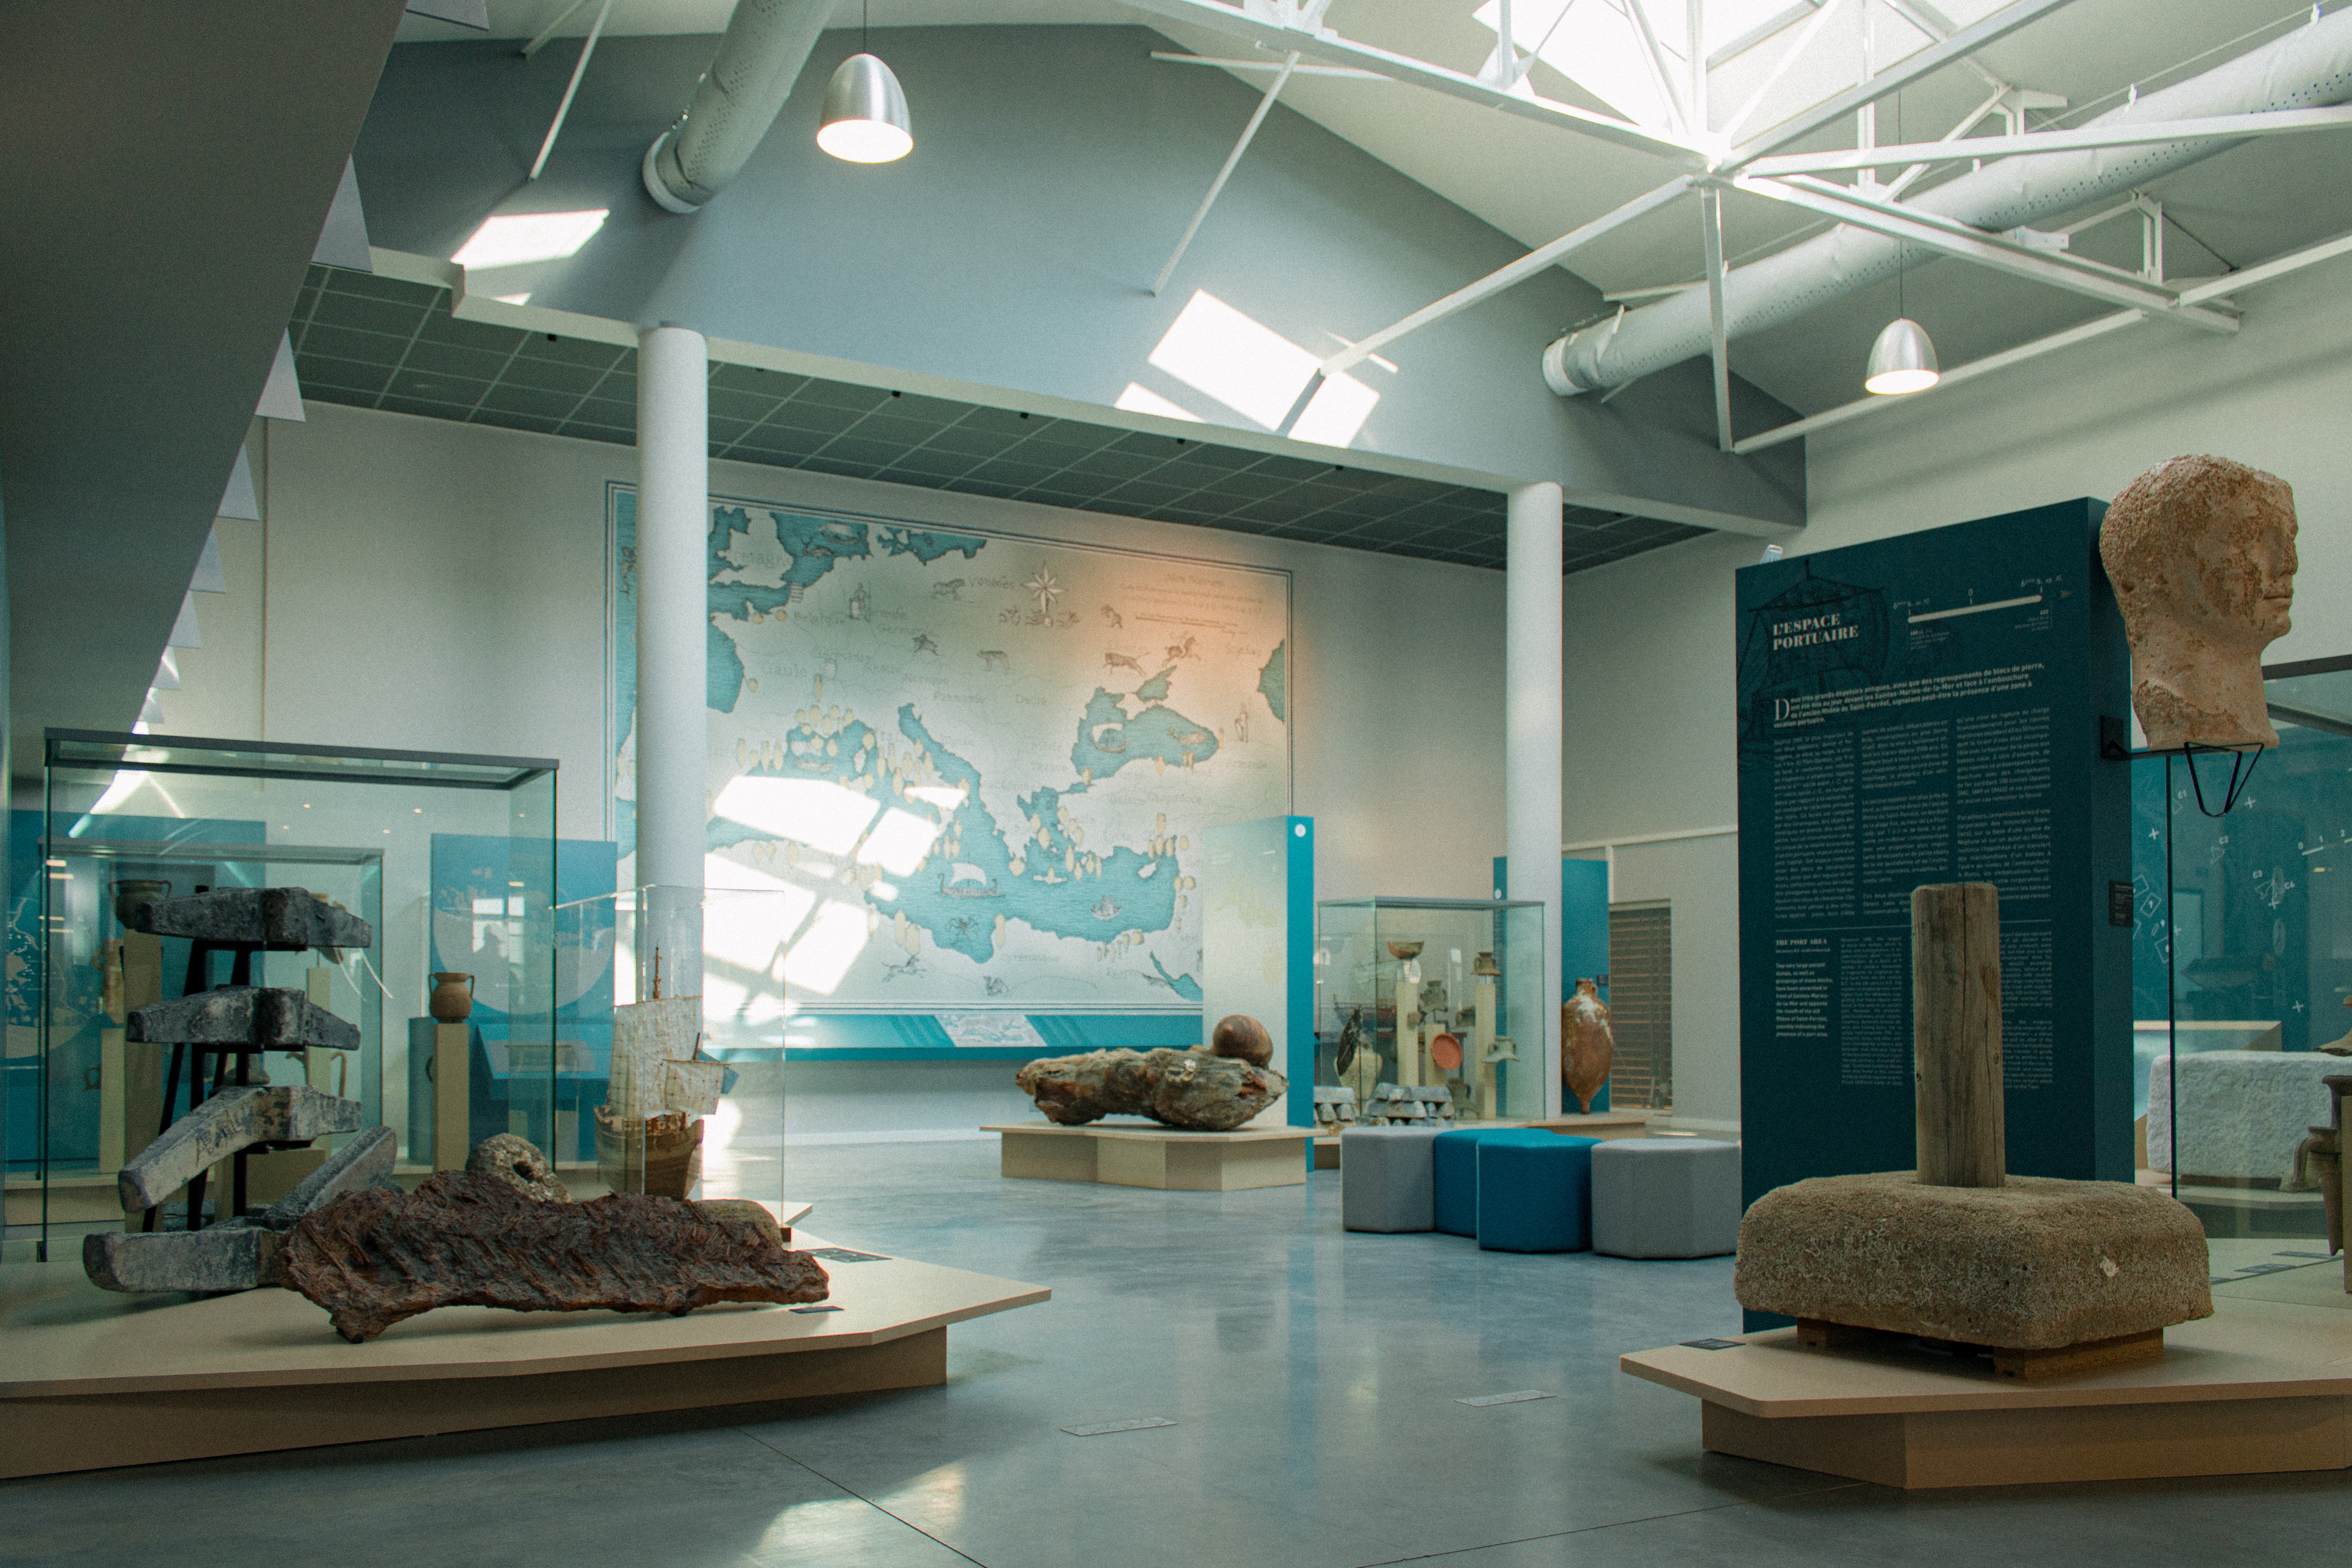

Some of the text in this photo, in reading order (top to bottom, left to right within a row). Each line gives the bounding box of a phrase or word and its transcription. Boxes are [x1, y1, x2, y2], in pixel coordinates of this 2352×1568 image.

[1969, 588, 1973, 596] 0
[1773, 613, 1840, 636] L'ESPACE
[1773, 625, 1858, 651] PORTUAIRE
[1815, 691, 1834, 700] grands
[1835, 688, 1862, 697] dépotoirs
[1933, 671, 1982, 684] regroupements
[2021, 662, 2045, 672] pierre,
[1875, 684, 1953, 699] Saintes-Maries-de-la-Mer
[1984, 673, 2029, 684] l'embouchure
[1850, 701, 1890, 711] Saint-Ferréol,
[1892, 697, 1920, 706] signalant
[1922, 692, 1951, 702] peut-être
[1960, 688, 1989, 697] présence
[1797, 717, 1825, 726] portuaire.
[2178, 789, 2187, 799] C1
[2219, 835, 2229, 845] C2
